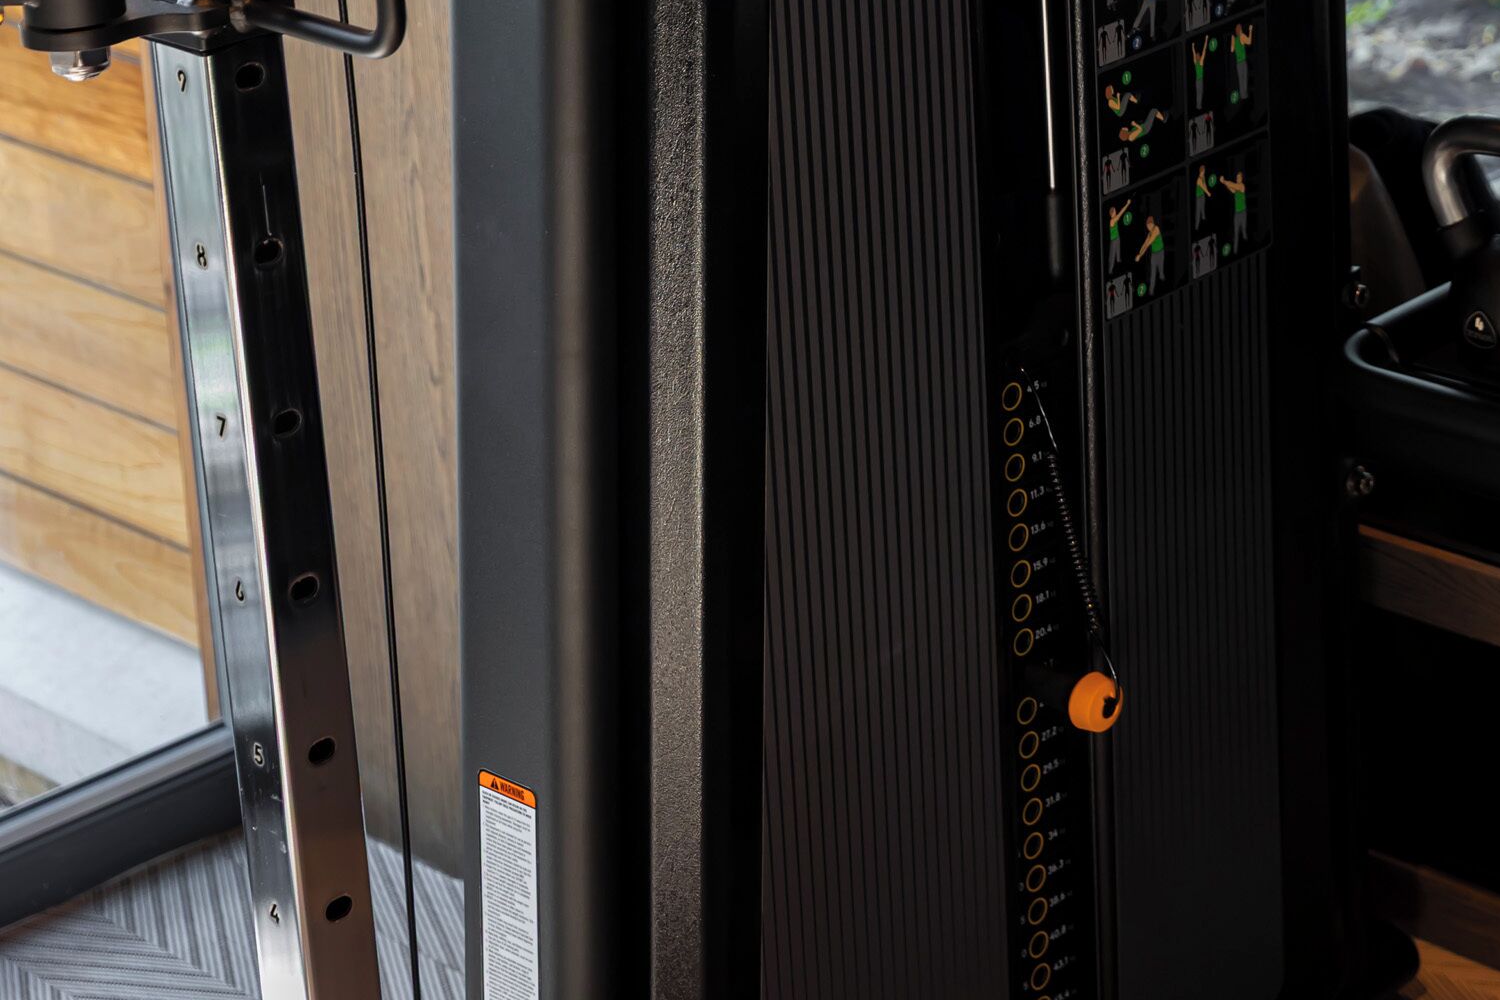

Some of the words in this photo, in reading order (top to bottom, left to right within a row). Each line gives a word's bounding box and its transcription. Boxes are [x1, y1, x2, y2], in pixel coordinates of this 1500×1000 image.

[177, 69, 187, 92] 9
[196, 243, 207, 267] 8
[1474, 316, 1485, 332] 4
[216, 415, 226, 437] 7
[235, 580, 244, 602] 6
[254, 743, 264, 766] 5
[500, 782, 525, 801] WARNING
[270, 903, 279, 924] 4
